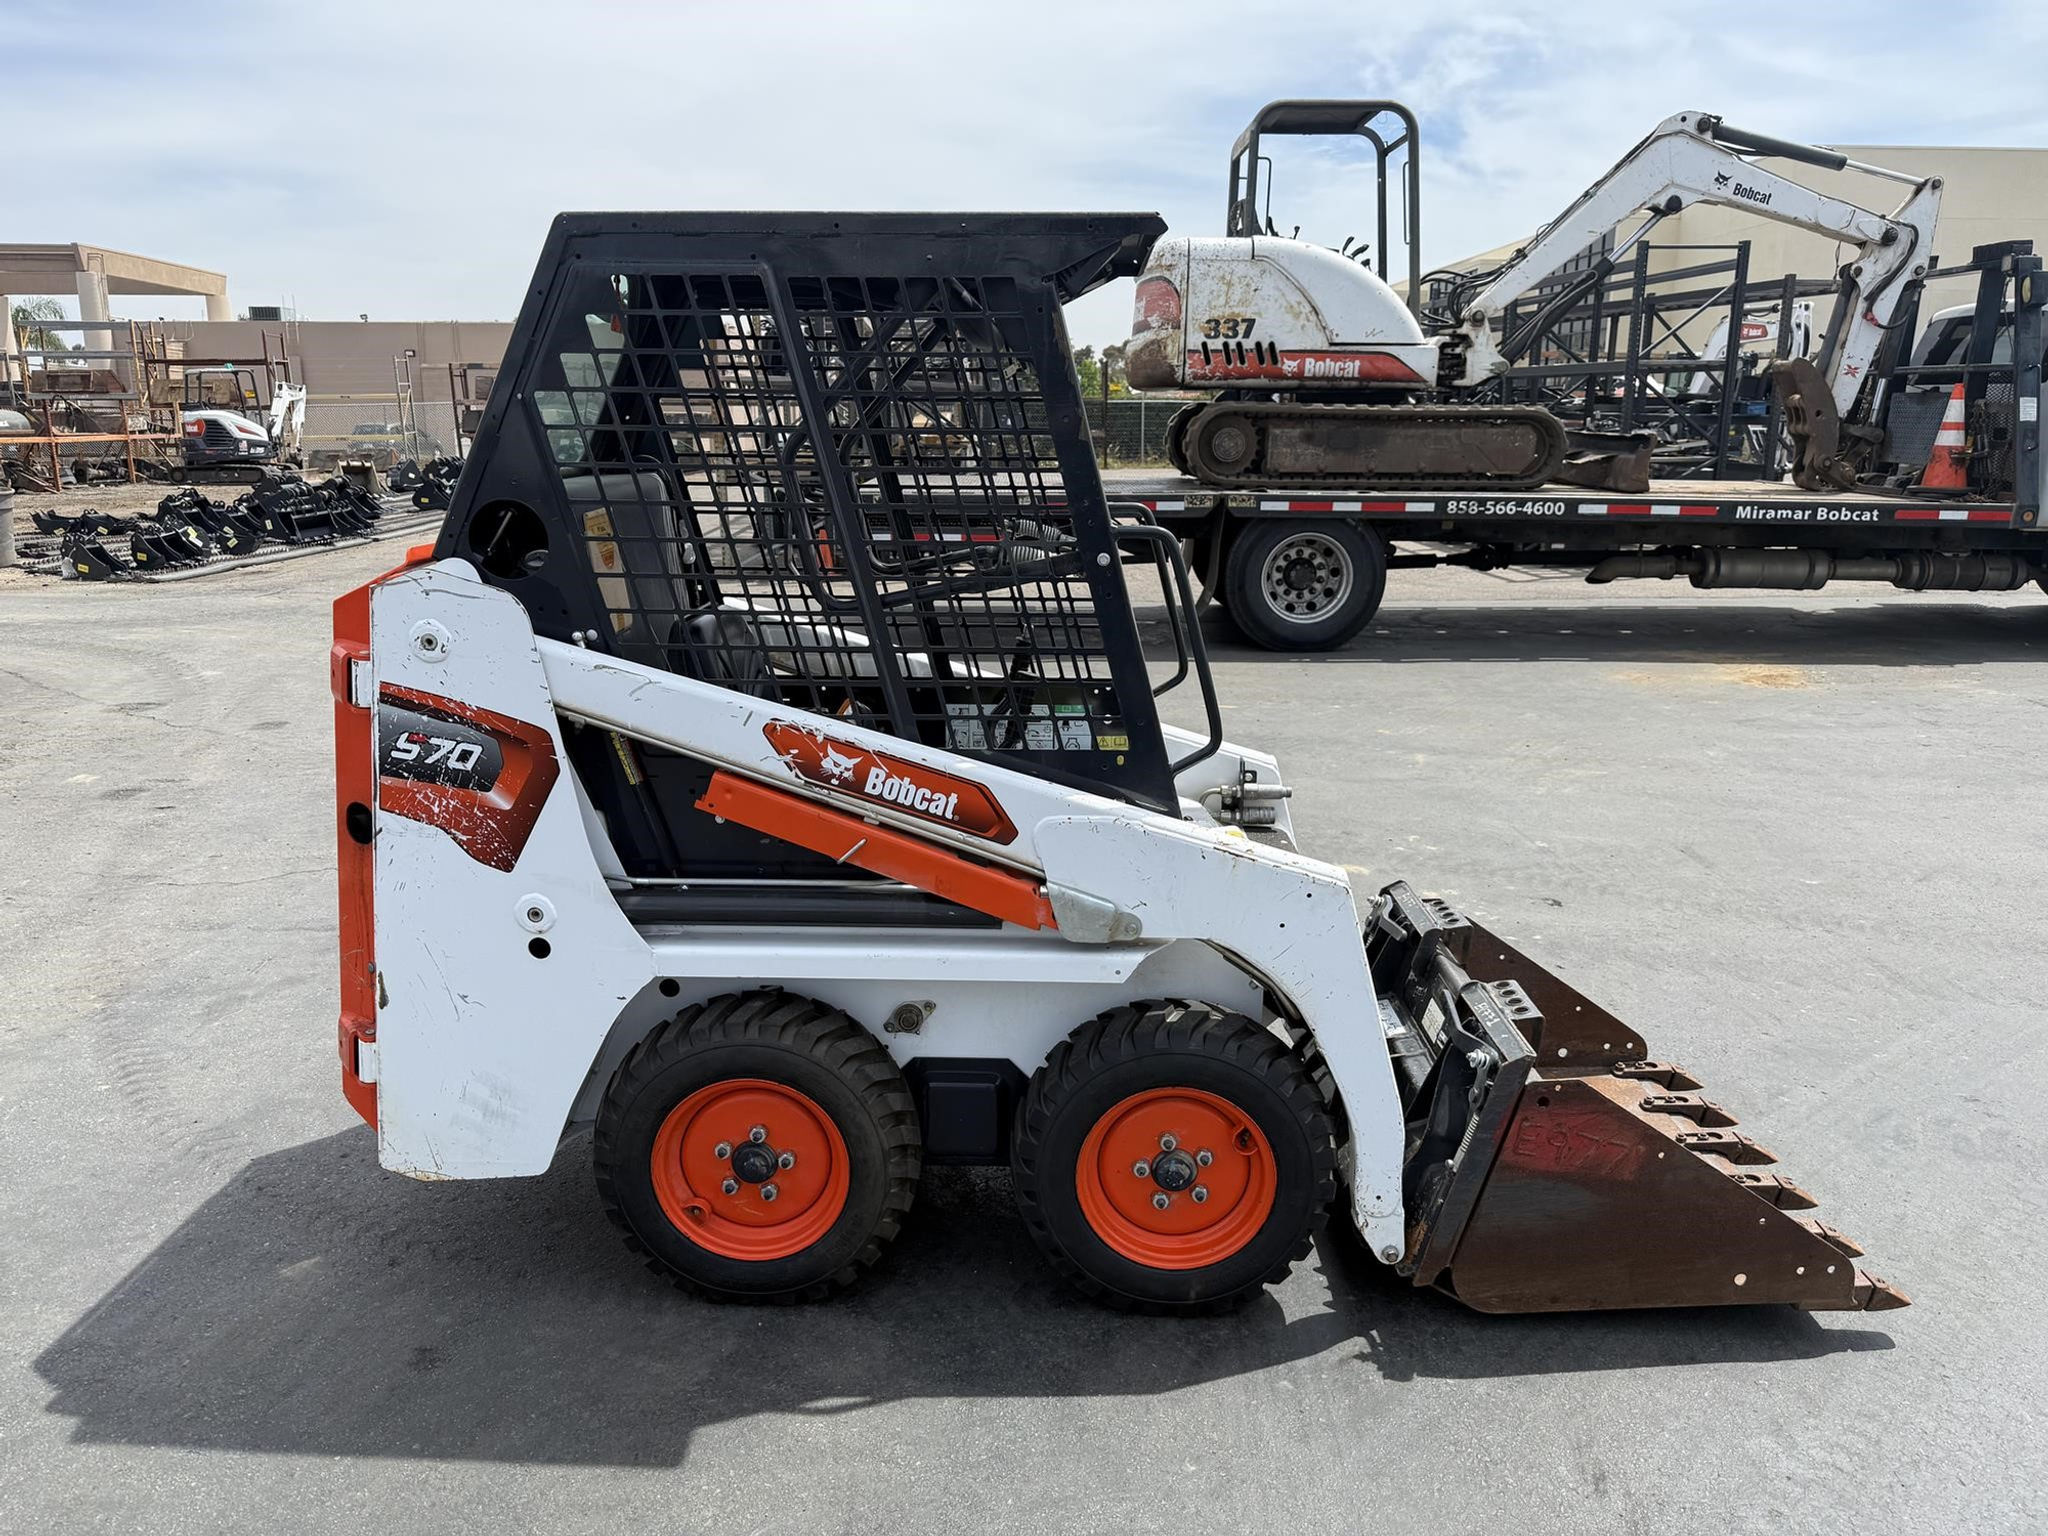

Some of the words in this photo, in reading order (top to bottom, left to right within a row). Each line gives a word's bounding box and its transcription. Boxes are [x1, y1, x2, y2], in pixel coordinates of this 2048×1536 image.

[1733, 183, 1772, 205] Bobcat
[1202, 318, 1256, 339] 337
[1304, 358, 1360, 377] Bobcat
[1447, 500, 1565, 515] 858-566-4600
[1735, 505, 1812, 520] Miramar
[1817, 507, 1879, 521] Bobcat
[391, 732, 483, 771] S70
[864, 766, 958, 820] Bobcat
